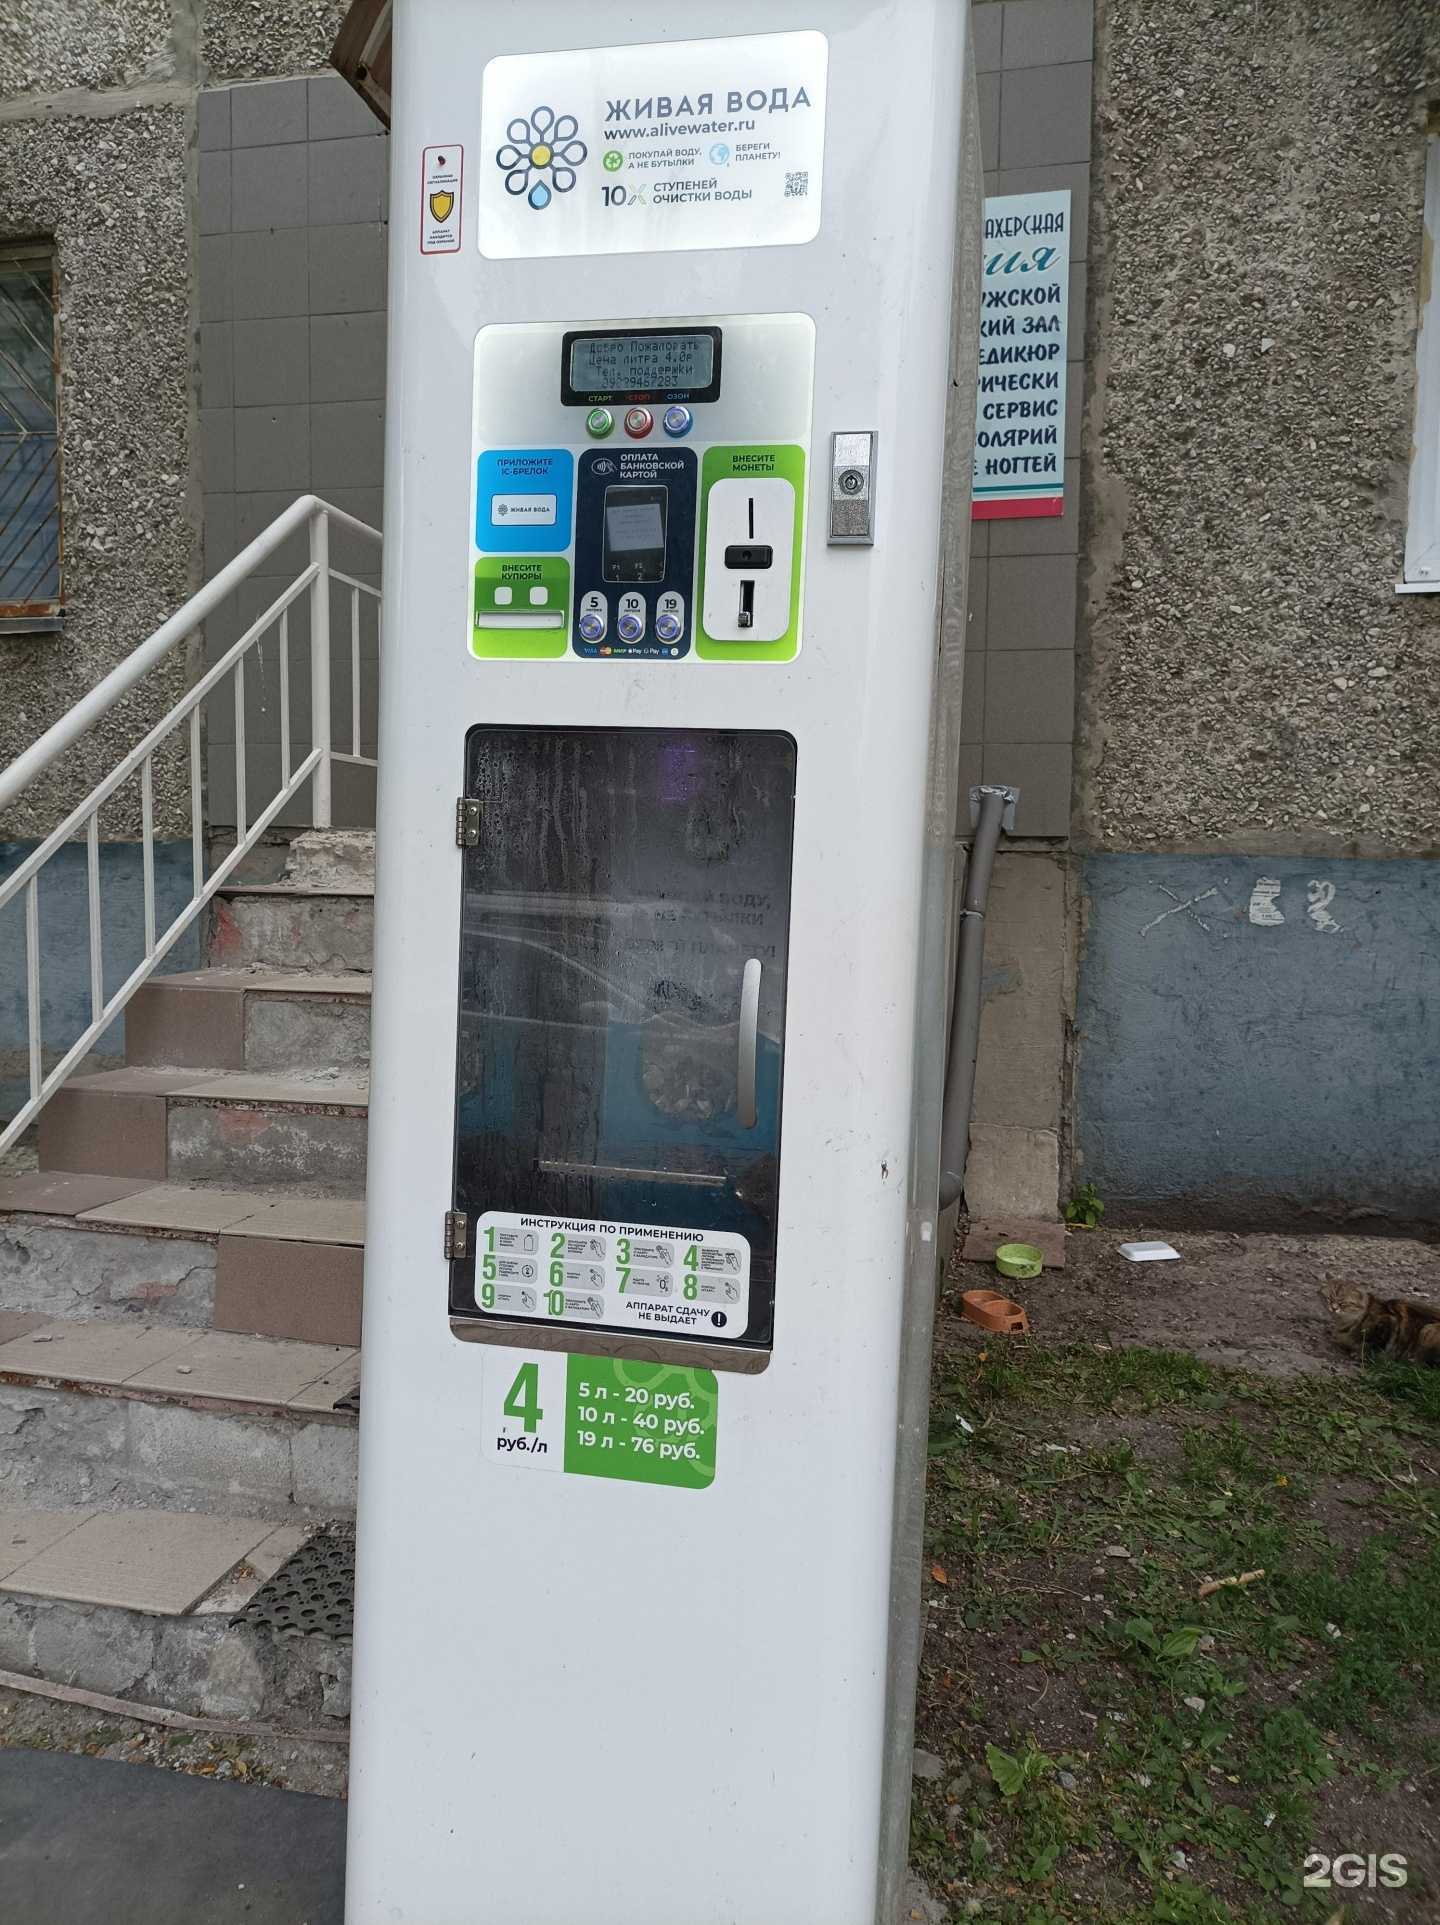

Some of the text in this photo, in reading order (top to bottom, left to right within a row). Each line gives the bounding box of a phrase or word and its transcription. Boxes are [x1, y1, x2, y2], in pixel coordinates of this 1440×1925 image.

[605, 86, 811, 122] ЖИВАЯ ВОДА
[604, 119, 755, 141] www.alivewater.ru
[628, 149, 673, 160] ПОКУПАЙ
[735, 151, 781, 162] ПЛАНЕТУ!
[736, 143, 770, 152] БЕРЕГИ
[628, 158, 695, 169] А НЕ БУТЫЛКИ
[653, 178, 718, 192] СТУПЕНЕЙ
[653, 189, 752, 204] ОЧИСТКИ ВОДЫ
[985, 212, 1064, 239] АХЕРСКАЯ
[984, 247, 1061, 276] ия
[982, 283, 1061, 308] ЖСКОЙ
[1022, 315, 1060, 333] ЗАЛ
[624, 354, 658, 365] литра
[630, 364, 693, 377] поддержки
[978, 372, 1059, 393] ИЧЕСКИ
[983, 399, 1058, 420] СЕРВИС
[976, 425, 1057, 448] ОЛЯРИЙ
[497, 458, 553, 467] ПРИЛОЖИТЕ
[620, 453, 659, 462] ОПЛАТА
[620, 460, 684, 470] БАНКОВСКОЙ
[732, 454, 775, 463] ВНЕСИТЕ
[732, 463, 774, 472] МОНЕТЫ
[985, 453, 1056, 476] НОГТЕЙ
[619, 469, 658, 479] КАРТОЙ
[501, 572, 542, 580] КУПЮРЫ
[502, 564, 542, 572] ВНЕСИТЕ
[590, 597, 599, 608] 5
[625, 599, 639, 609] 10
[665, 599, 677, 609] 19
[484, 1226, 495, 1252] 1
[520, 1217, 704, 1242] ИНСТРУКЦИЯ ПО ПРИМЕНЕНИЮ
[550, 1232, 565, 1259] 2
[617, 1238, 630, 1264] 3
[483, 1254, 496, 1280] 5
[683, 1245, 699, 1271] 4
[550, 1261, 564, 1287] 6
[616, 1267, 631, 1293] 7
[481, 1283, 495, 1309] 9
[683, 1274, 698, 1301] 8
[543, 1290, 564, 1316] 10
[626, 1301, 710, 1317] АППАРАТ СДАЧУ
[638, 1312, 697, 1325] НЕ ВЫДАЕТ
[503, 1362, 544, 1434] 4
[578, 1382, 590, 1397] 5
[594, 1387, 607, 1400] л
[624, 1387, 649, 1404] 20
[654, 1391, 694, 1410] руб.
[577, 1406, 598, 1422] 10
[602, 1411, 615, 1425] л
[633, 1413, 658, 1430] 40
[664, 1416, 704, 1436] руб.
[497, 1436, 548, 1453] руб./л
[577, 1430, 596, 1446] 19
[600, 1435, 613, 1449] л
[631, 1437, 655, 1453] 76
[659, 1441, 700, 1460] руб.
